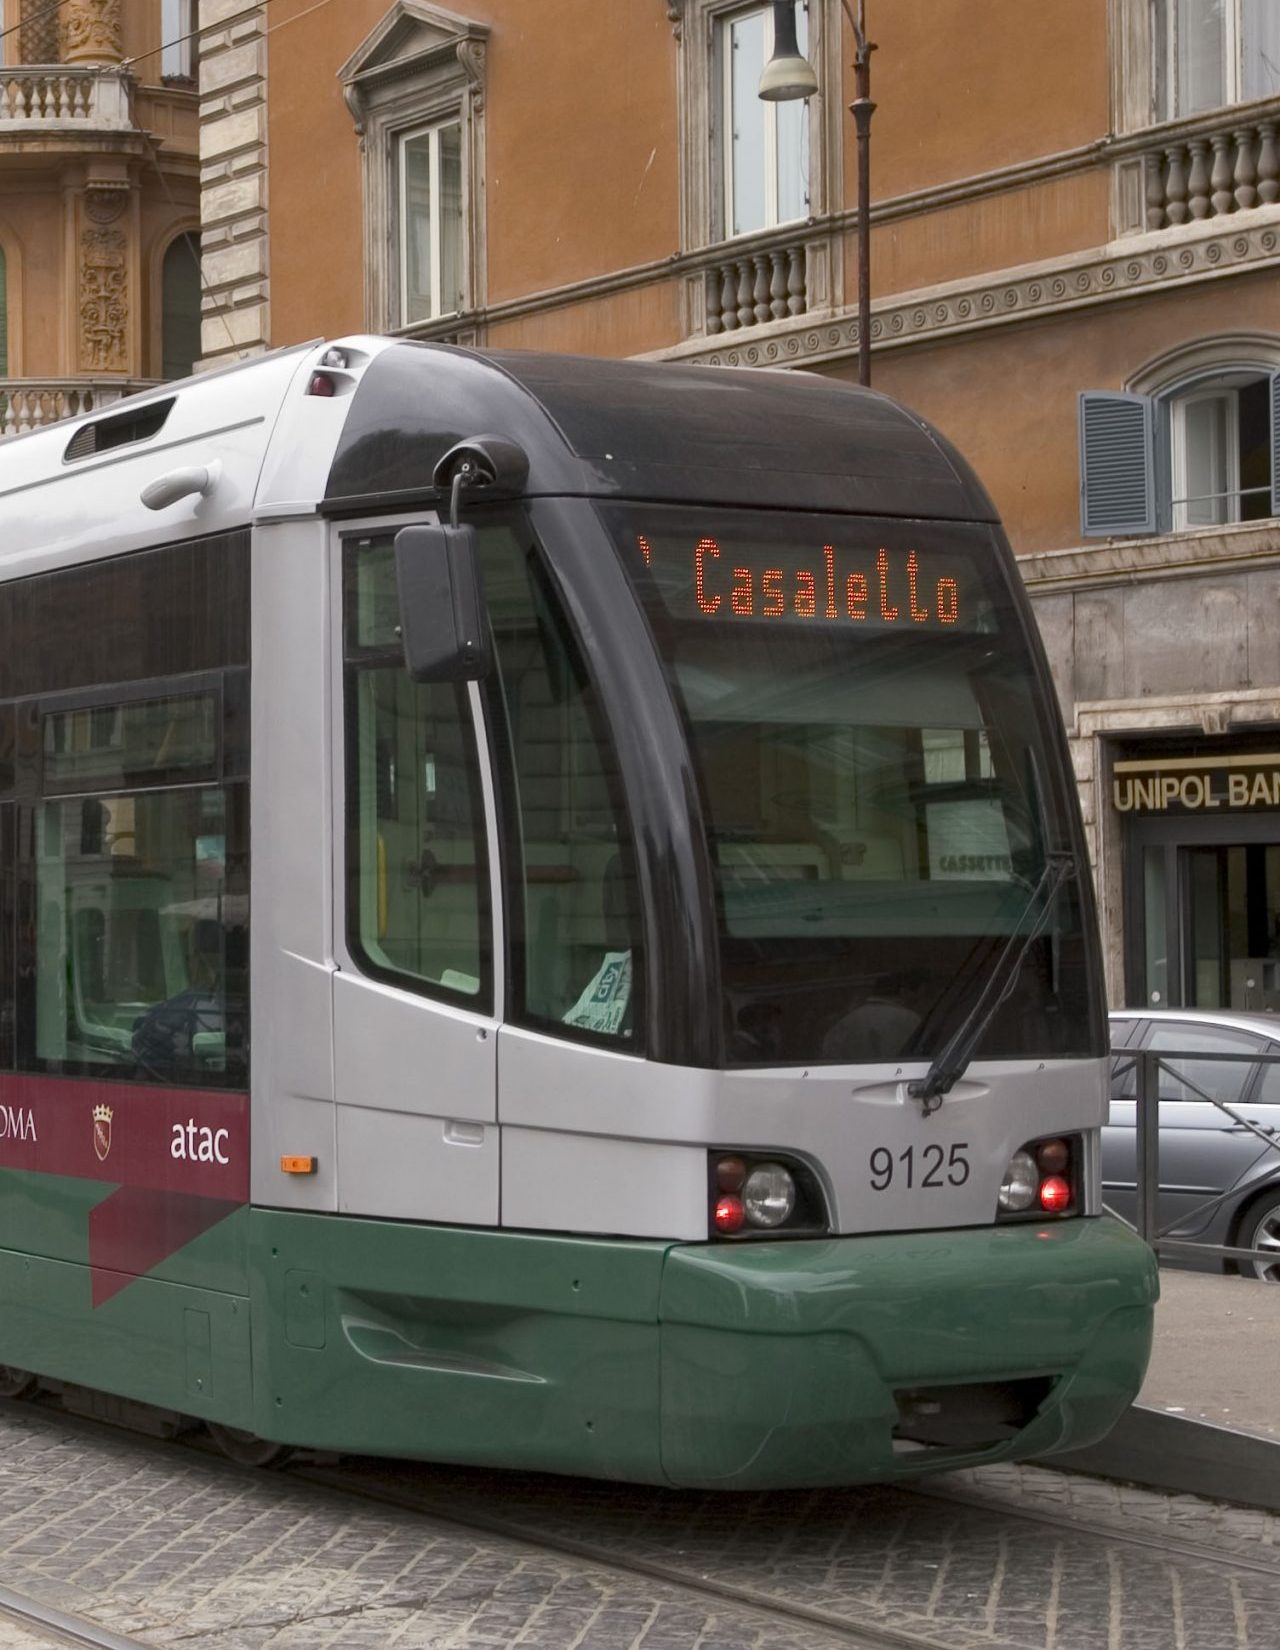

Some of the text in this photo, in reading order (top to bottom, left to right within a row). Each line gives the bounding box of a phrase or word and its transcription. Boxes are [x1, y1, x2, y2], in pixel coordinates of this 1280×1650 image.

[695, 537, 958, 624] Casaletto
[1113, 775, 1220, 812] UNIPOL
[597, 966, 619, 999] city
[170, 1118, 230, 1164] atac
[869, 1143, 970, 1191] 9125
